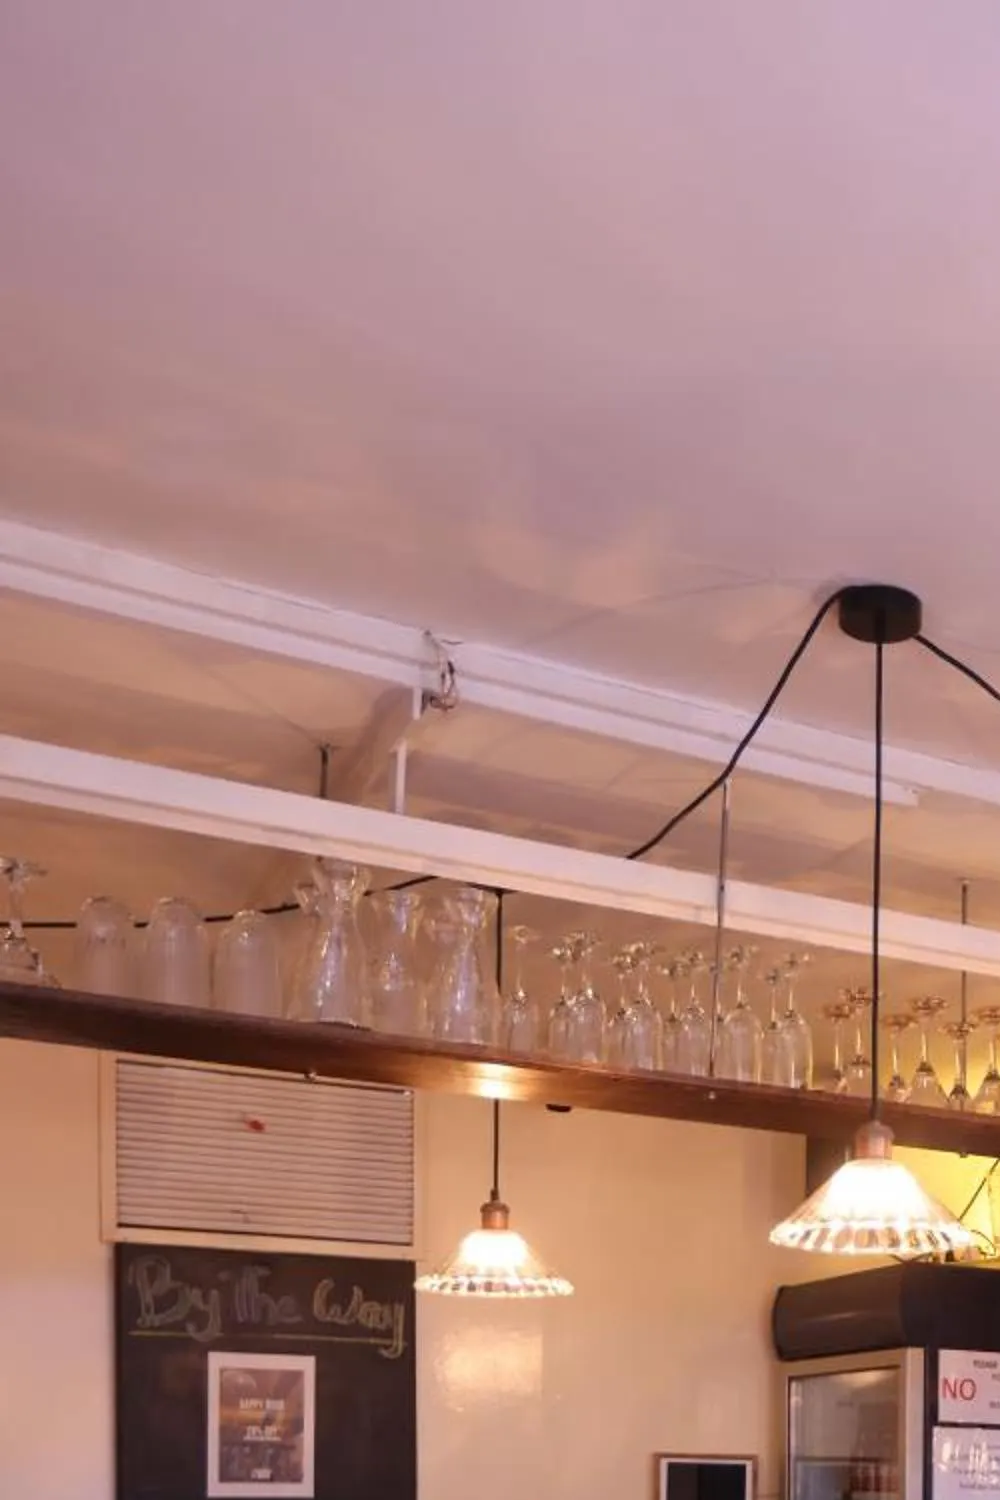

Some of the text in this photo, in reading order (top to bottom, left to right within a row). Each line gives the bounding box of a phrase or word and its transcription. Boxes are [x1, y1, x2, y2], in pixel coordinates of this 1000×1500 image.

[128, 1254, 406, 1360] By The Way
[942, 1377, 977, 1401] NO
